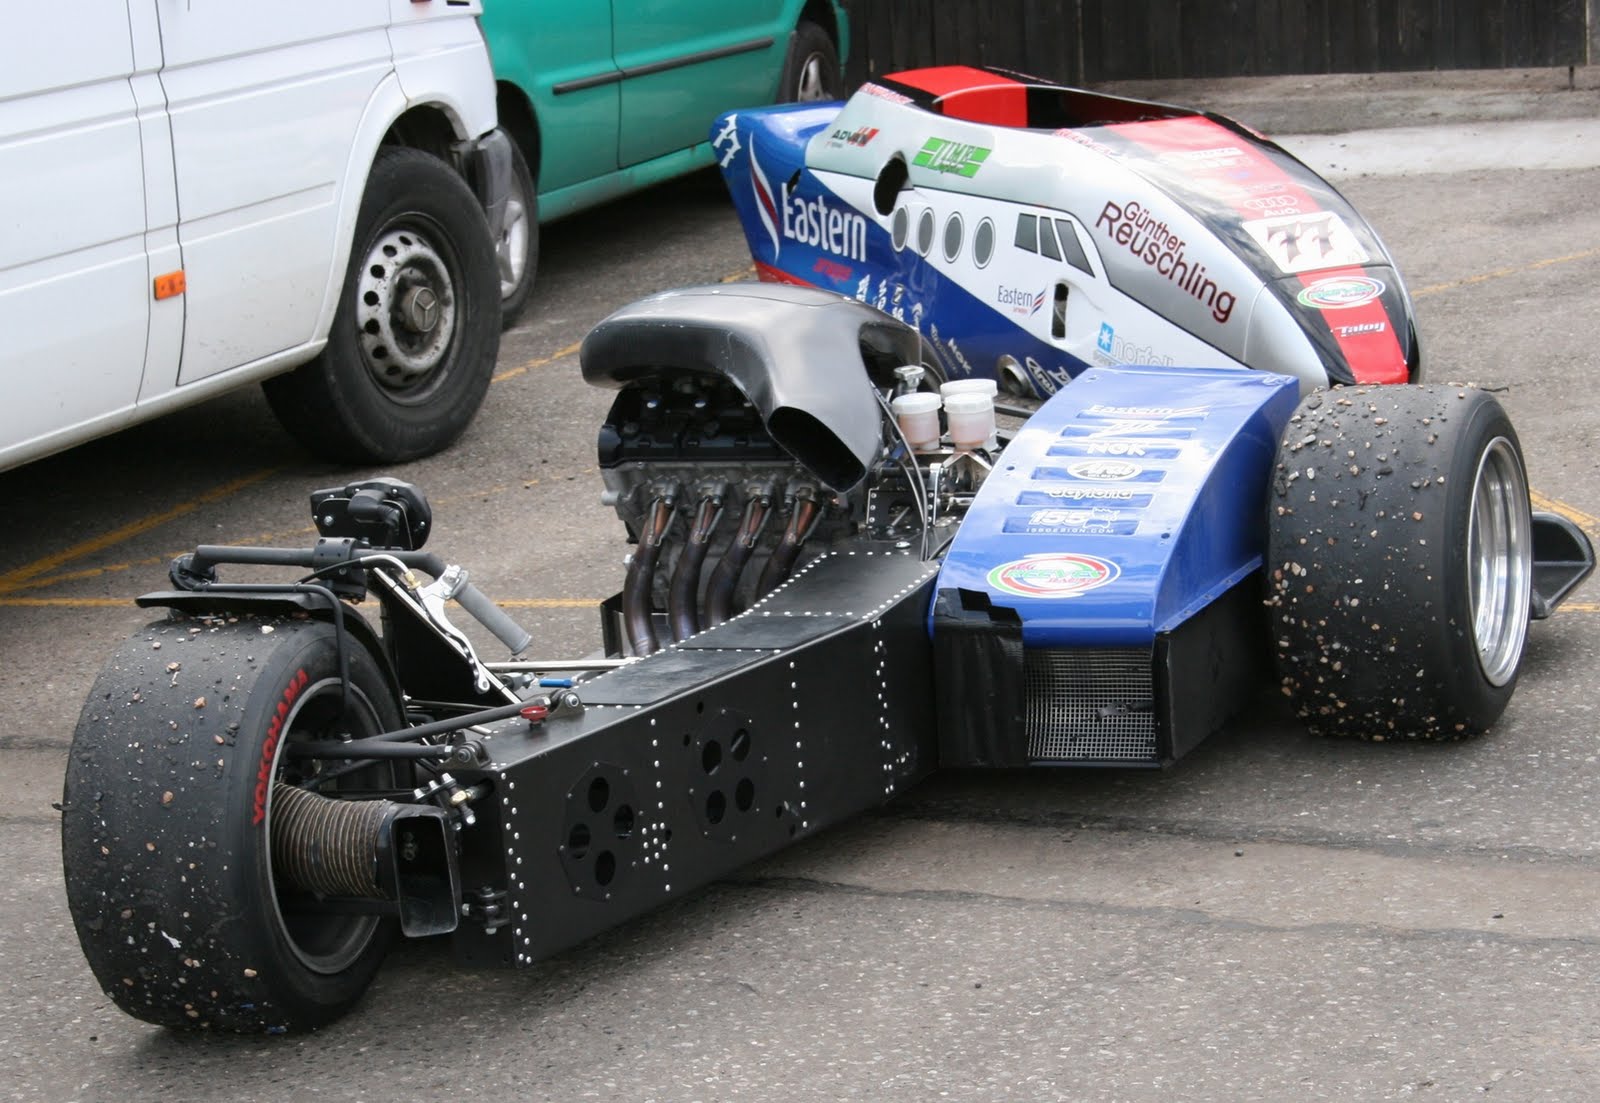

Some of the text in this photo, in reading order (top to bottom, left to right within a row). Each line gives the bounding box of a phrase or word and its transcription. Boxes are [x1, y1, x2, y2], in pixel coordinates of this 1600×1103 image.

[781, 182, 866, 262] Eastern
[1123, 201, 1186, 254] Günther
[1267, 215, 1335, 264] 77
[1095, 200, 1236, 324] Reuschling
[997, 284, 1033, 308] Eastern
[1113, 335, 1175, 367] norf
[1087, 441, 1147, 456] NGK
[252, 668, 308, 825] YOKOHAMA
